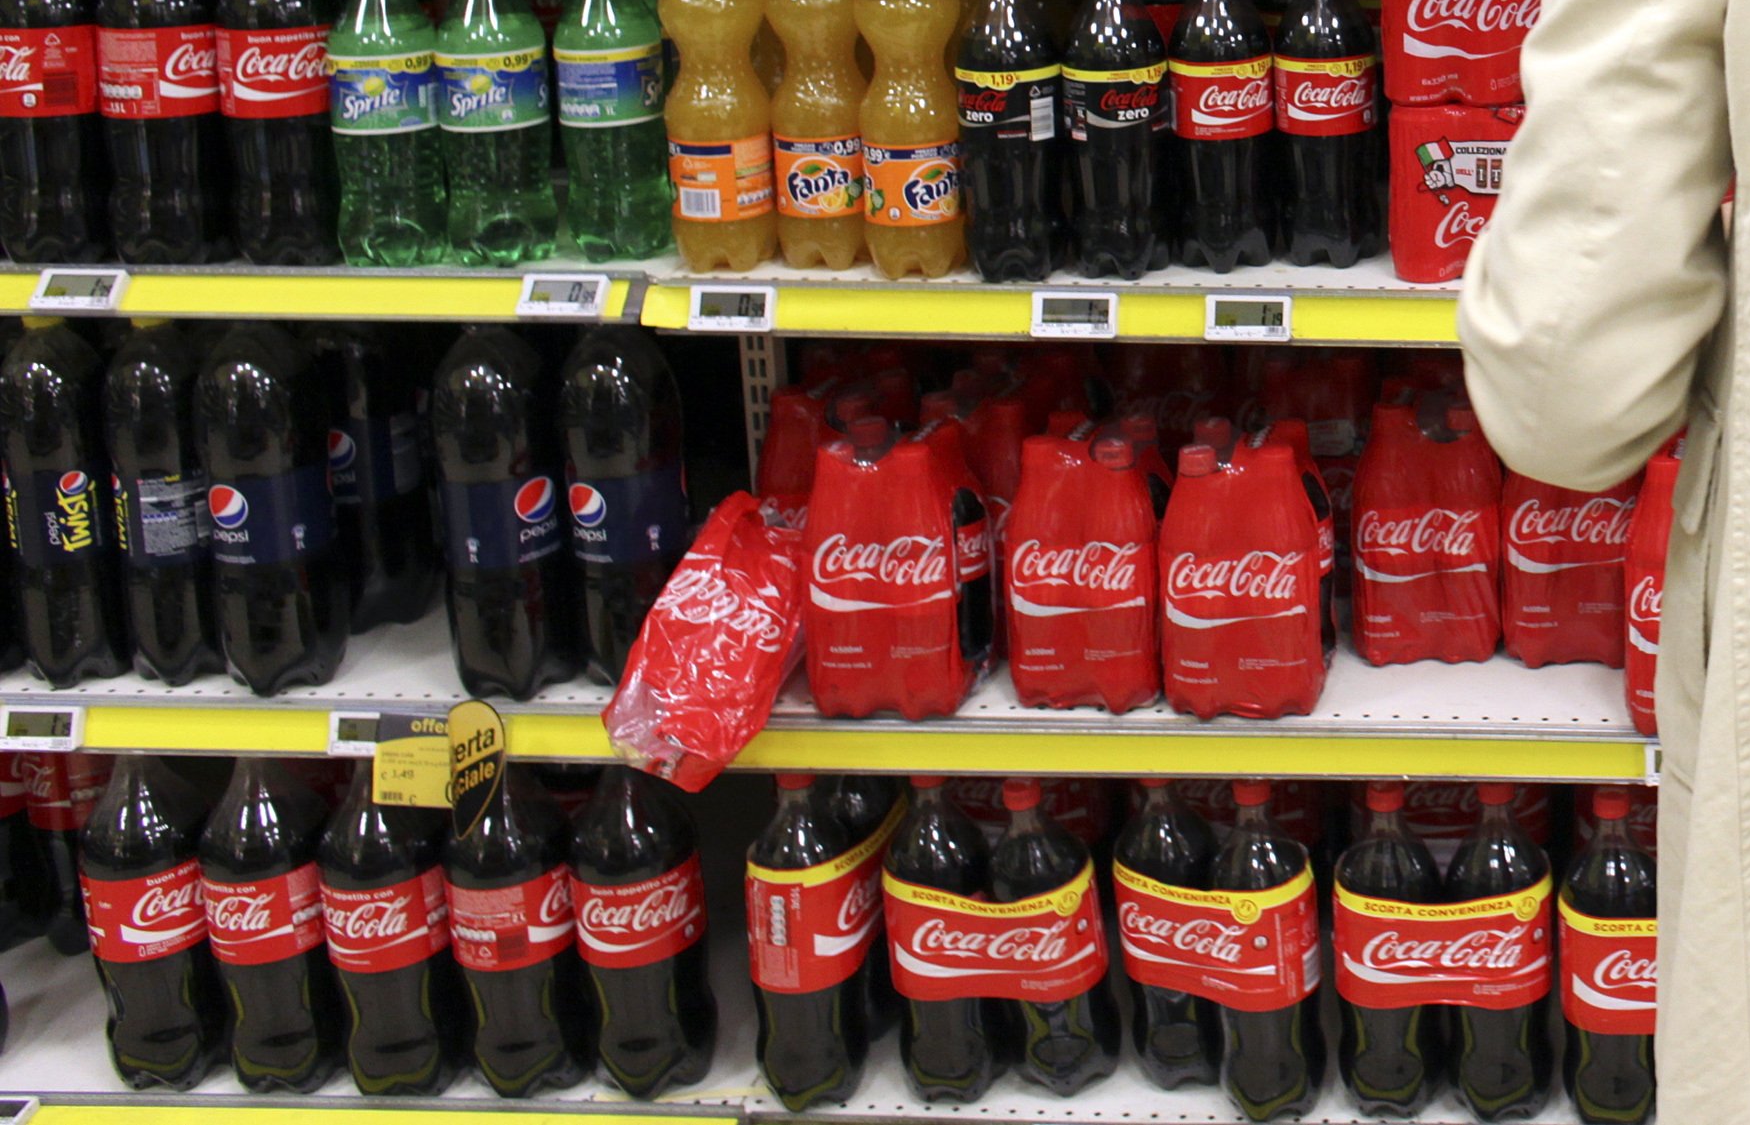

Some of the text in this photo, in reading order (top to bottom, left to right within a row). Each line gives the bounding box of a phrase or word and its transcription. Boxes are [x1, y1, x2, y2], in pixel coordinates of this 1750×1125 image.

[343, 85, 401, 121] Sprite
[451, 84, 507, 121] Sprite
[1199, 78, 1272, 113] Coca-Cola
[1293, 77, 1367, 109] Coca-Cola
[965, 109, 994, 124] zero
[1117, 107, 1150, 123] zero
[787, 167, 850, 202] Fanta
[213, 528, 249, 545] pepsi
[1357, 508, 1482, 556] Coca-Cola
[812, 532, 948, 586] Coca-Cola
[1012, 539, 1141, 591] Coca-Cola
[1167, 549, 1306, 600] Coca-Cola
[582, 877, 692, 934] Coca-Cola
[911, 889, 1054, 915] SCORTA CONVENIENZA
[1363, 898, 1514, 919] SCORTA CONVENIENZA
[912, 919, 1073, 963] Coca-Cola
[1119, 901, 1243, 964] Coca-Cola
[1593, 922, 1642, 934] SCORTA
[1362, 927, 1524, 970] Coca-Cola
